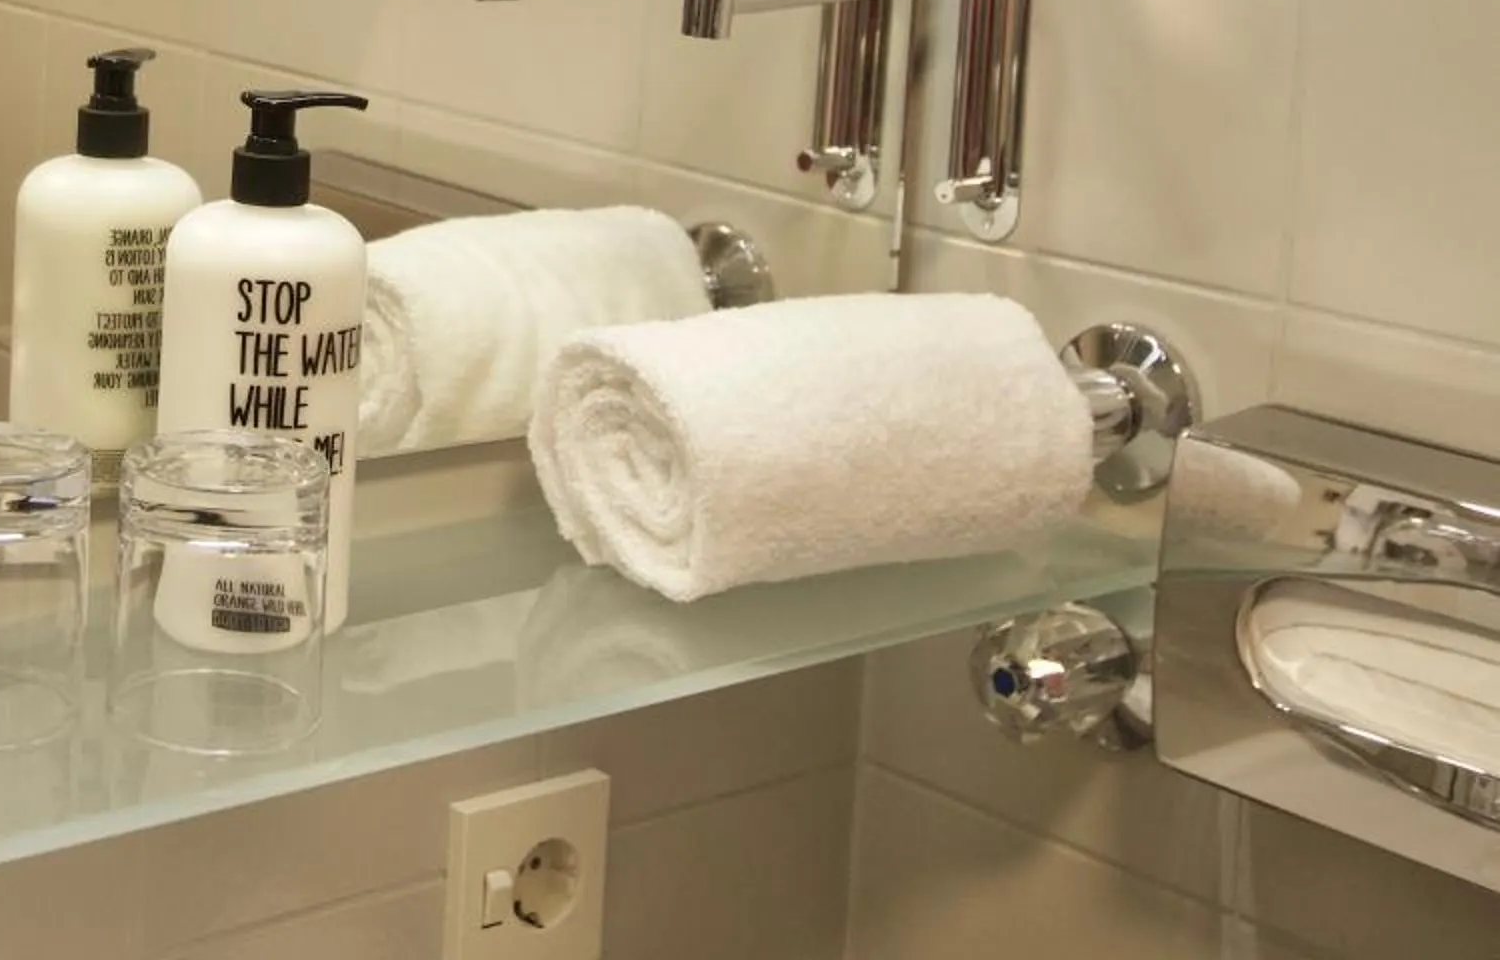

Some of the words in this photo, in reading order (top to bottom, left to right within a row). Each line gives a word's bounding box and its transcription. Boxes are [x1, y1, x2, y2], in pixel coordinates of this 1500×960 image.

[237, 278, 312, 325] STOP
[234, 330, 290, 377] THE
[229, 383, 309, 429] WHILE
